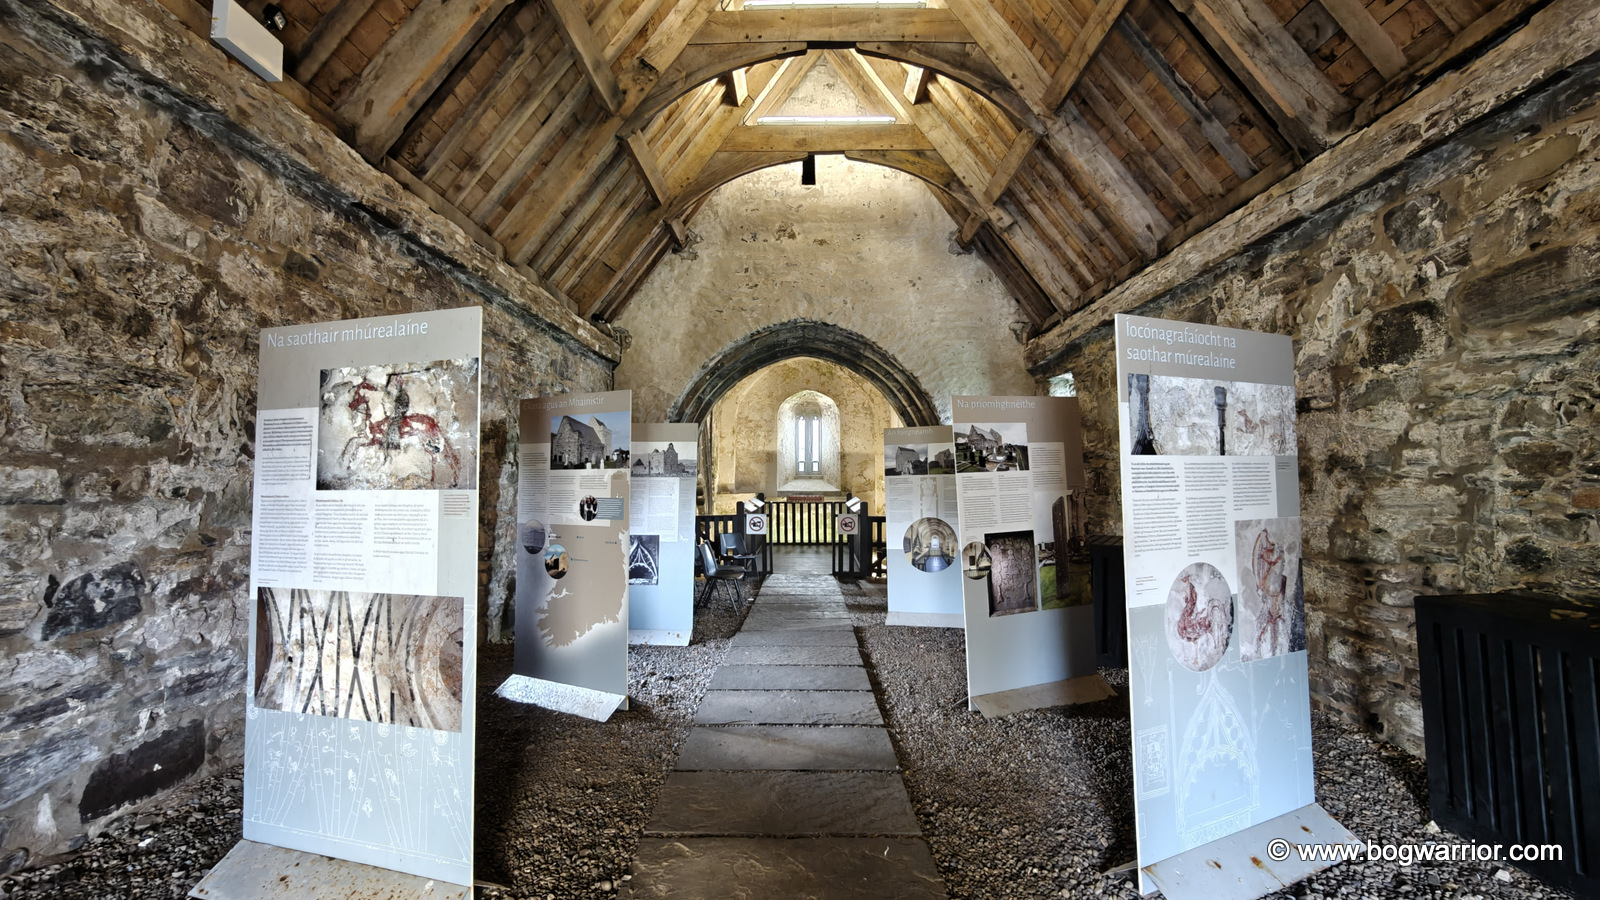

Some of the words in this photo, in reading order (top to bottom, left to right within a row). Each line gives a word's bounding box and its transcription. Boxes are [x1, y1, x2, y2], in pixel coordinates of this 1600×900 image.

[267, 333, 285, 348] Na
[287, 327, 339, 347] saothair
[341, 318, 429, 342] mhúrealaíne
[1125, 317, 1222, 347] Íocónagrafaíocht
[1223, 336, 1237, 349] na
[1126, 345, 1172, 364] saothar
[1174, 349, 1237, 369] múrealaíne
[543, 401, 558, 411] agus
[568, 395, 605, 407] Mhainistir
[957, 399, 969, 408] Na
